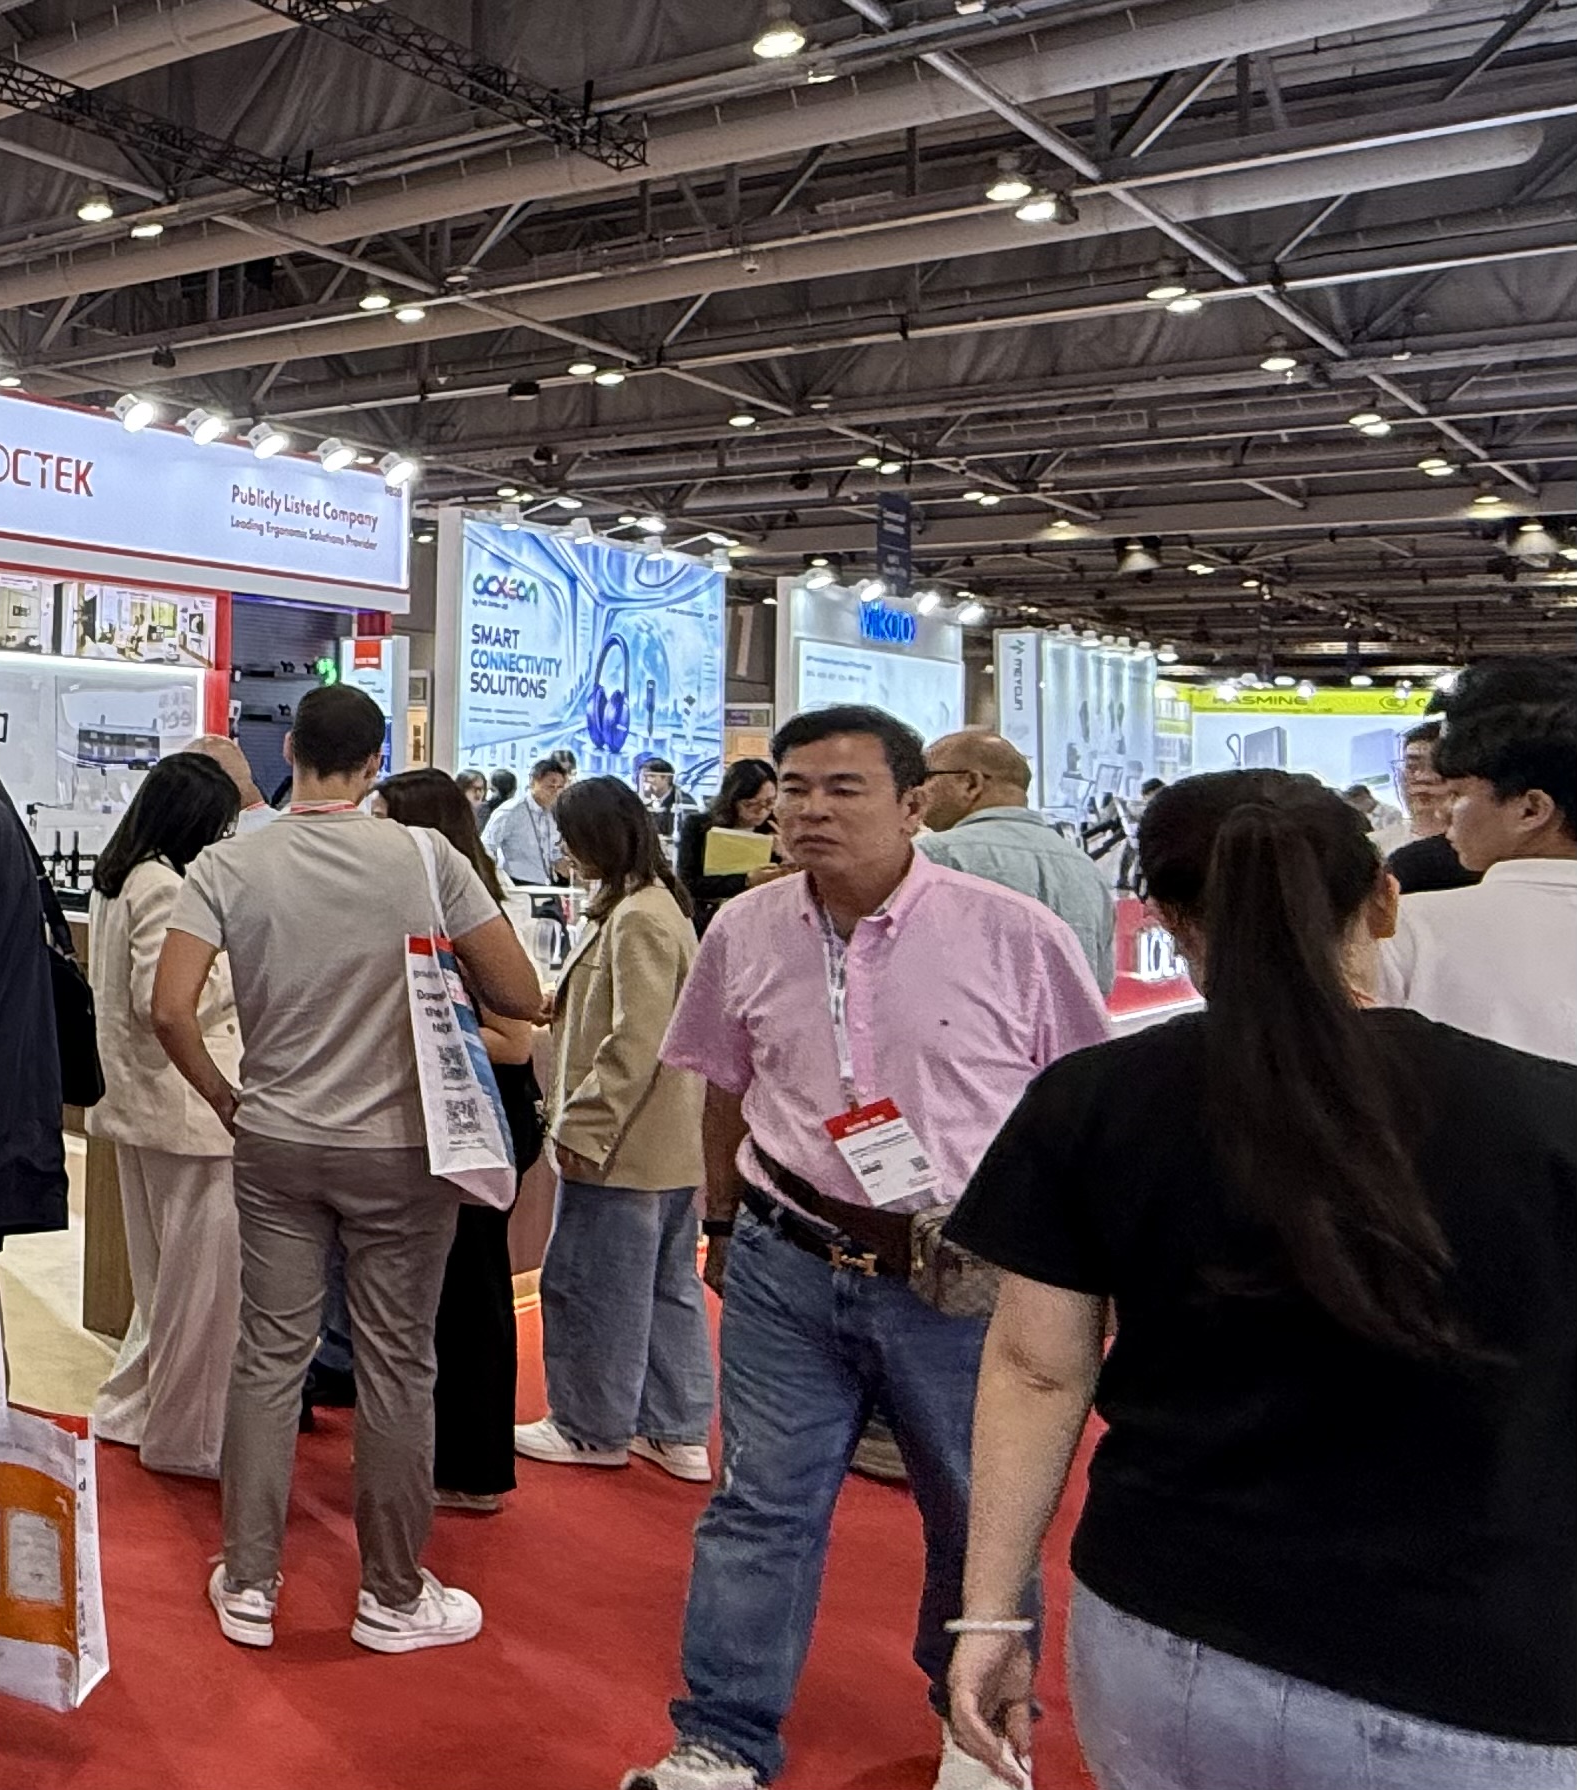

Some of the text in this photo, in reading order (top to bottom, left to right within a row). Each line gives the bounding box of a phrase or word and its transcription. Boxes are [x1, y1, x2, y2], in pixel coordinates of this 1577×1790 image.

[231, 484, 379, 532] Publicly Listed Company
[230, 515, 264, 536] Leading
[345, 534, 378, 550] Provider
[471, 623, 520, 650] SMART
[470, 648, 563, 678] CONNECTIVITY
[470, 671, 548, 699] SOLUTIONS
